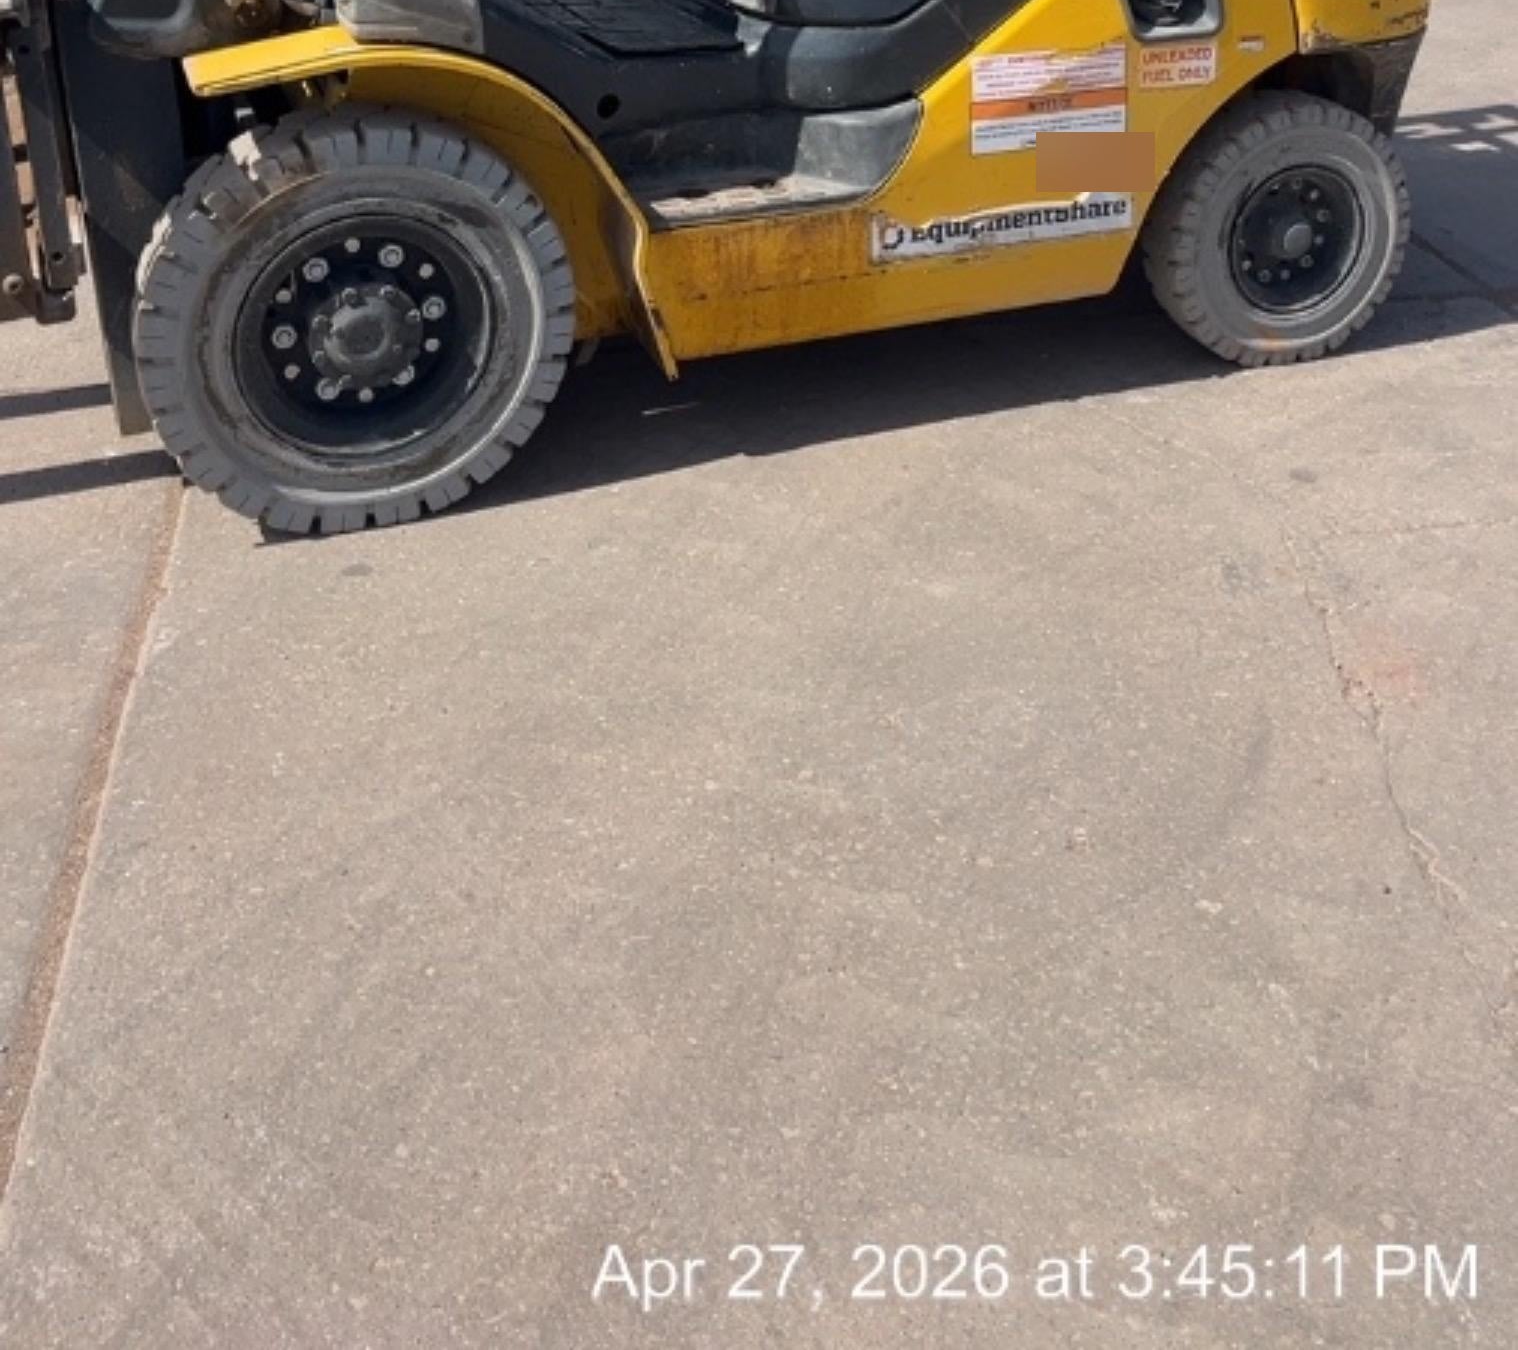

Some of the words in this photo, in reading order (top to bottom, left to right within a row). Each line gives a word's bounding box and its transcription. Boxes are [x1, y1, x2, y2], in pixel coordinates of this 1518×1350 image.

[1142, 46, 1213, 65] UNLEADED
[1142, 68, 1173, 83] FUEL
[1178, 65, 1210, 81] ONLY
